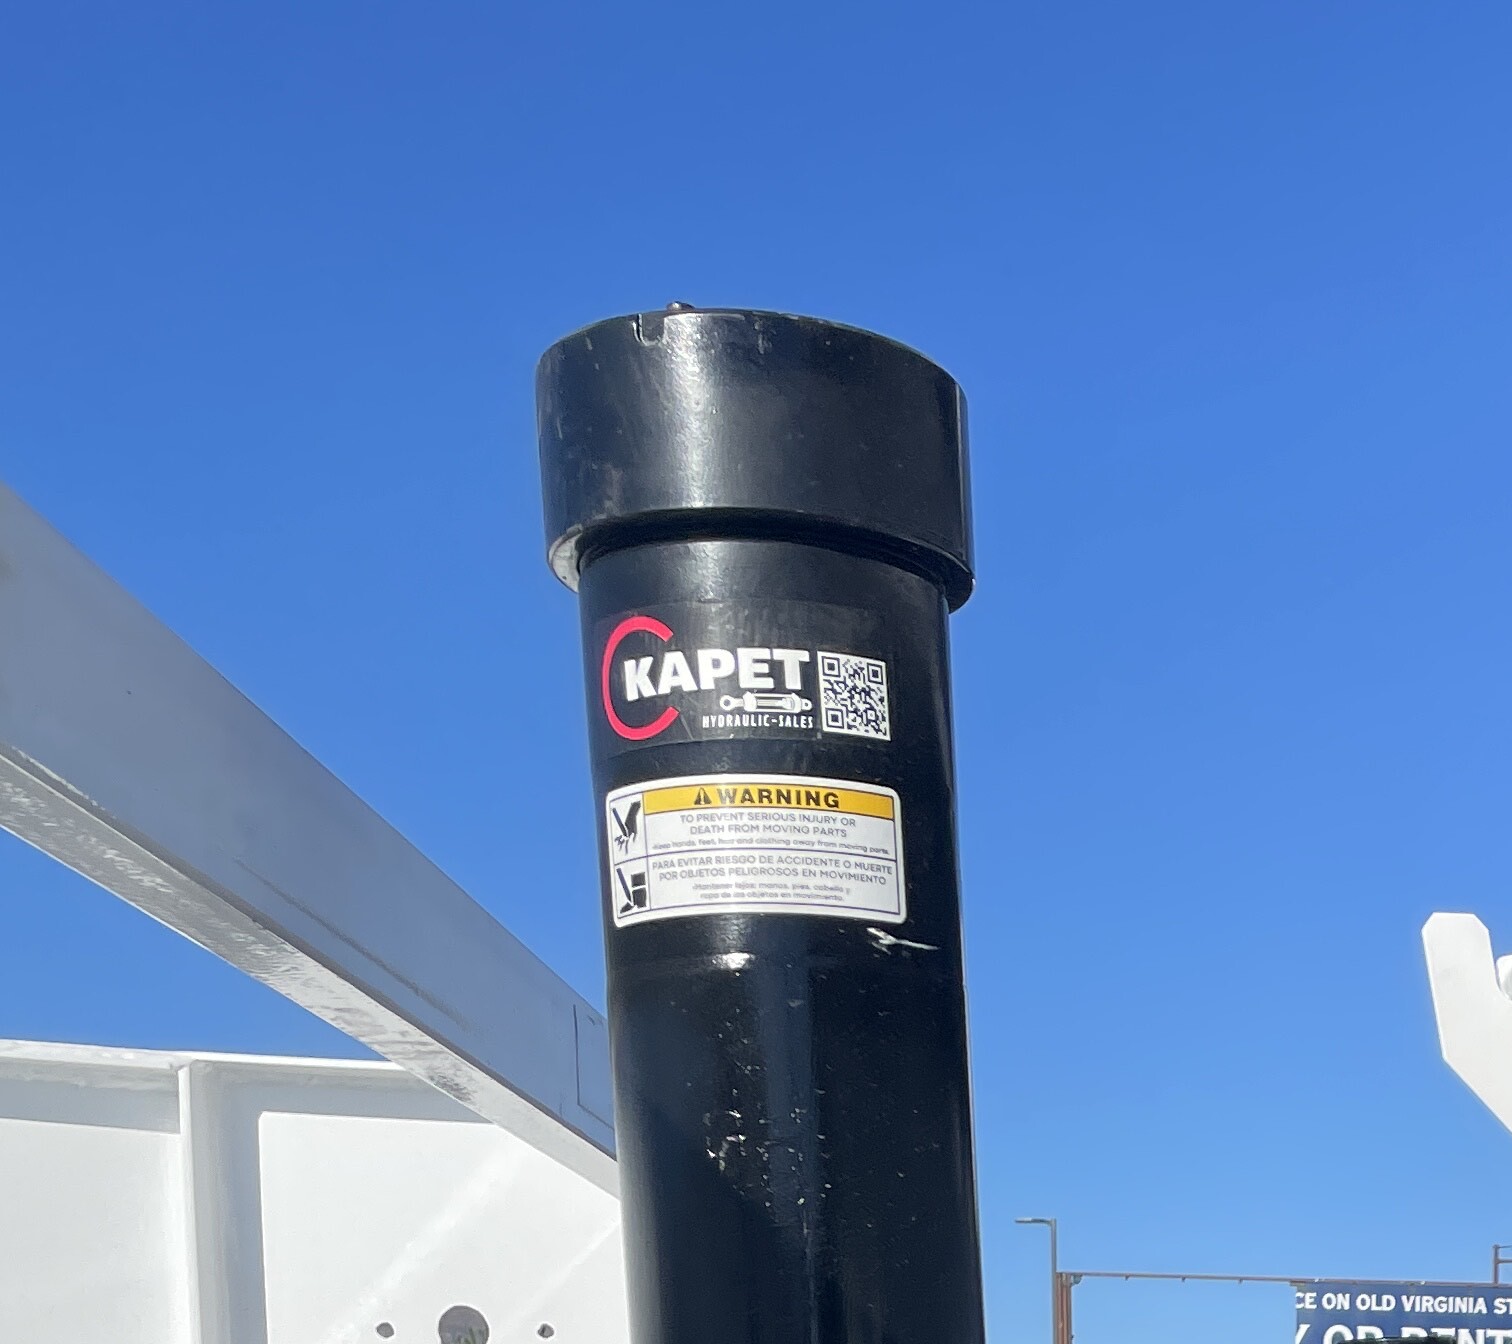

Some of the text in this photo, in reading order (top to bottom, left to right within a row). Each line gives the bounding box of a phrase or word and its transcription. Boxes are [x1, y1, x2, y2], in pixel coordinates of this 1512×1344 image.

[624, 648, 810, 701] KAPET
[702, 713, 813, 729] HYDRAULIC-SALES
[716, 788, 839, 808] WARNING
[680, 812, 856, 827] TO PREVENT SERIOUS INJURY OR
[690, 824, 847, 838] DEATH FROM MOVING PARTS
[652, 855, 893, 875] PARA EVITAR RIESGO DE ACCIDENTE O MUERTE
[659, 867, 887, 885] POR OBJETOS PELIGROSOS EN MOVIMIENTO
[1321, 1292, 1350, 1311] ON
[1355, 1293, 1396, 1312] OLD
[1401, 1294, 1488, 1315] VIRGINIA
